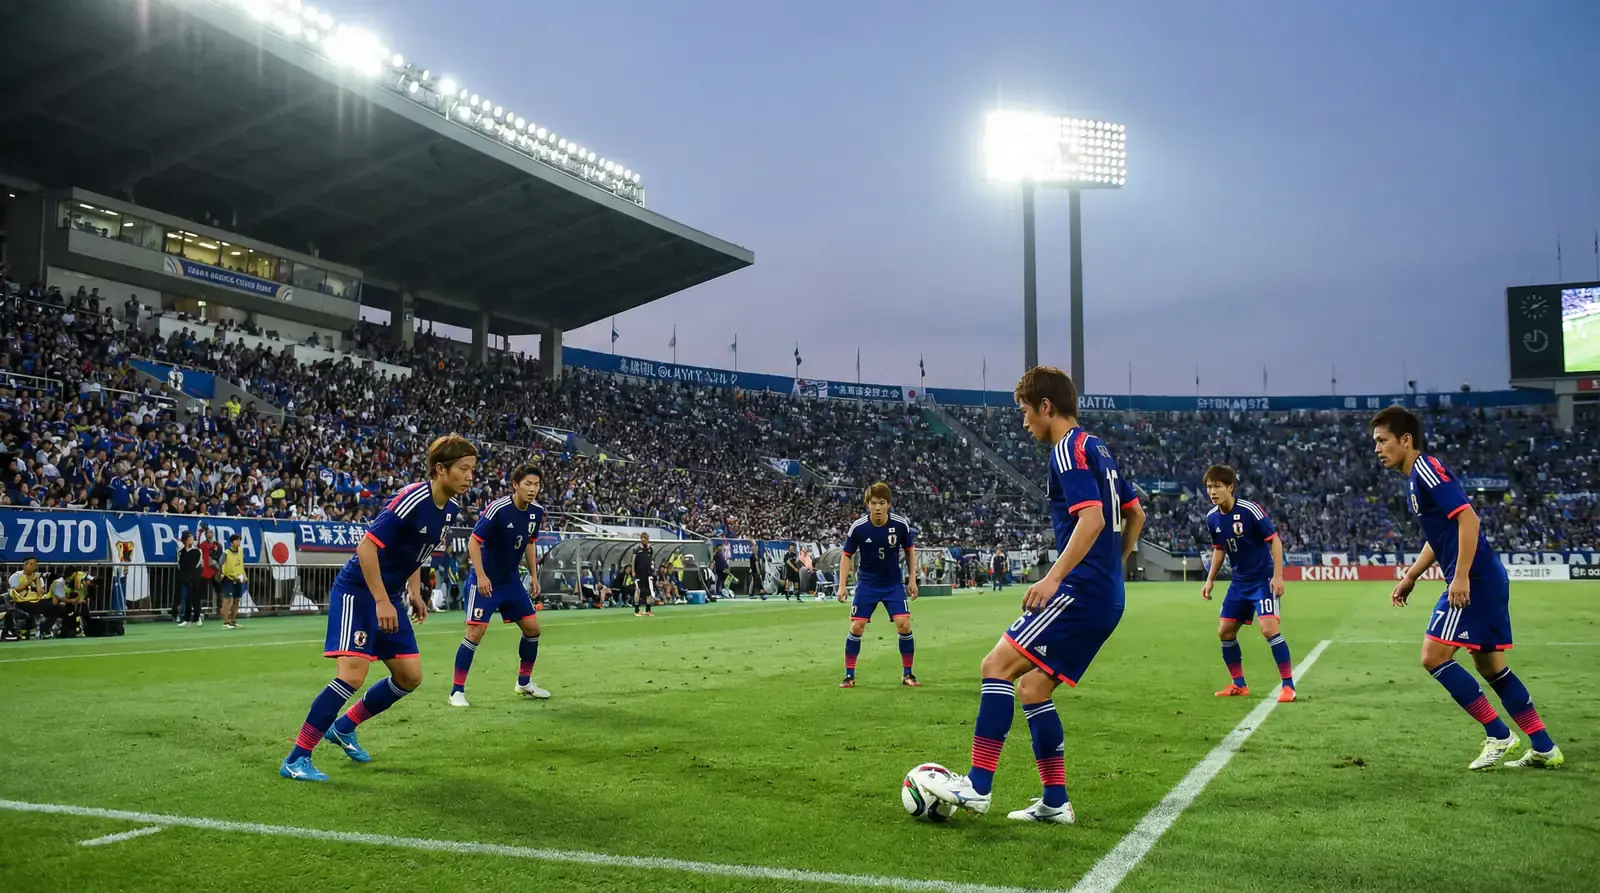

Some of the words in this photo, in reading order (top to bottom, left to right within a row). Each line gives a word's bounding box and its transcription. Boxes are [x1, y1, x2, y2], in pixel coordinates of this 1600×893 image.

[15, 518, 97, 553] ZOTO
[514, 535, 523, 550] 3
[1226, 538, 1238, 553] 13
[878, 548, 885, 559] 5
[1259, 599, 1273, 613] 10
